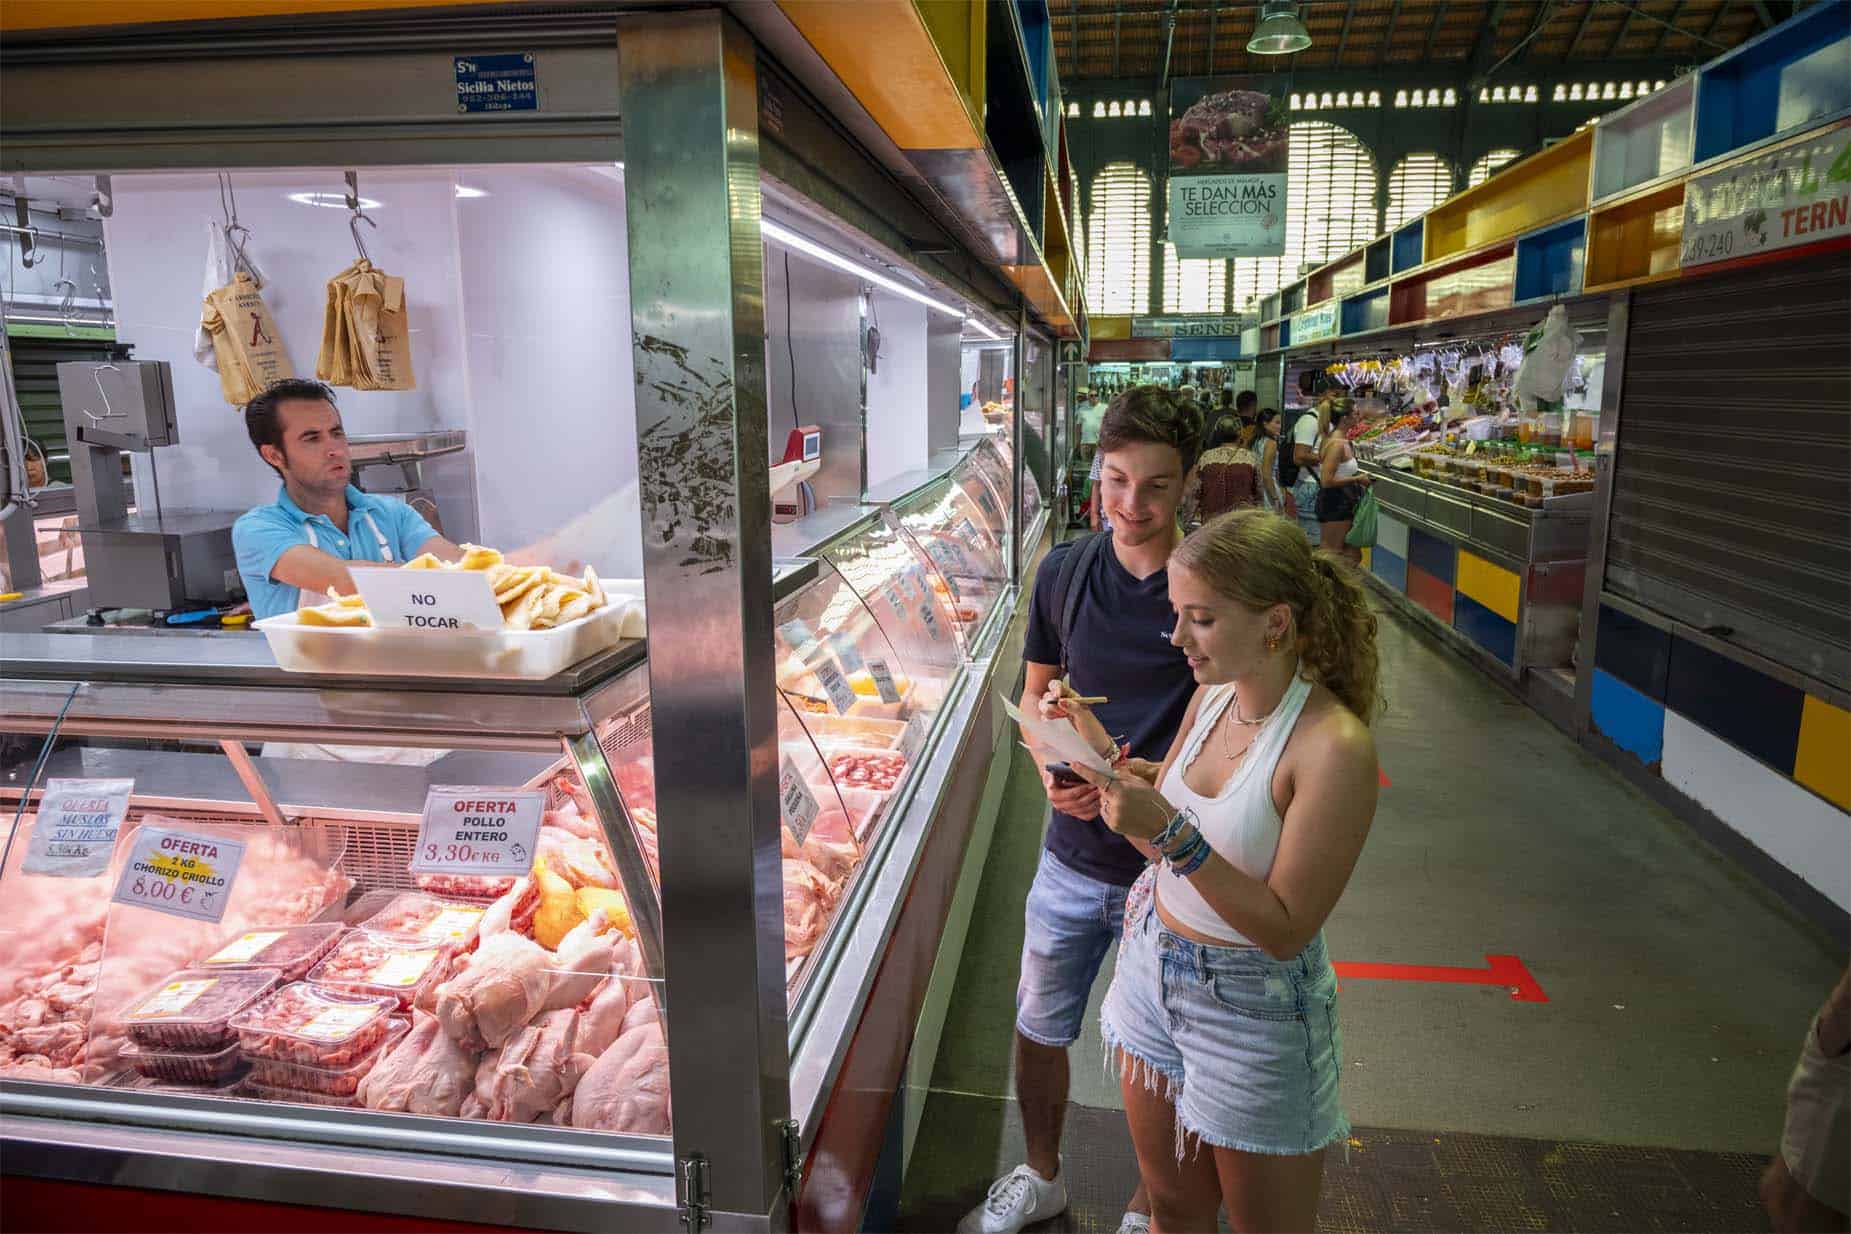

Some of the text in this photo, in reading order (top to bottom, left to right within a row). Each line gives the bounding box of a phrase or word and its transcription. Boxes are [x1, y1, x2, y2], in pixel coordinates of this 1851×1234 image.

[457, 80, 534, 93] Sicilia Nietos
[1180, 181, 1277, 201] TE DAN MÁS
[1781, 194, 1851, 238] TERN
[411, 594, 436, 606] NO
[405, 615, 459, 629] TOCAR
[454, 801, 517, 814] OFERTA
[463, 817, 506, 828] POLLO
[455, 831, 508, 842] ENTERO
[160, 837, 218, 859] OFERTA
[171, 856, 196, 869] 2 KG
[133, 862, 225, 887] CHORIZO CRIOLLO
[181, 886, 195, 904] €
